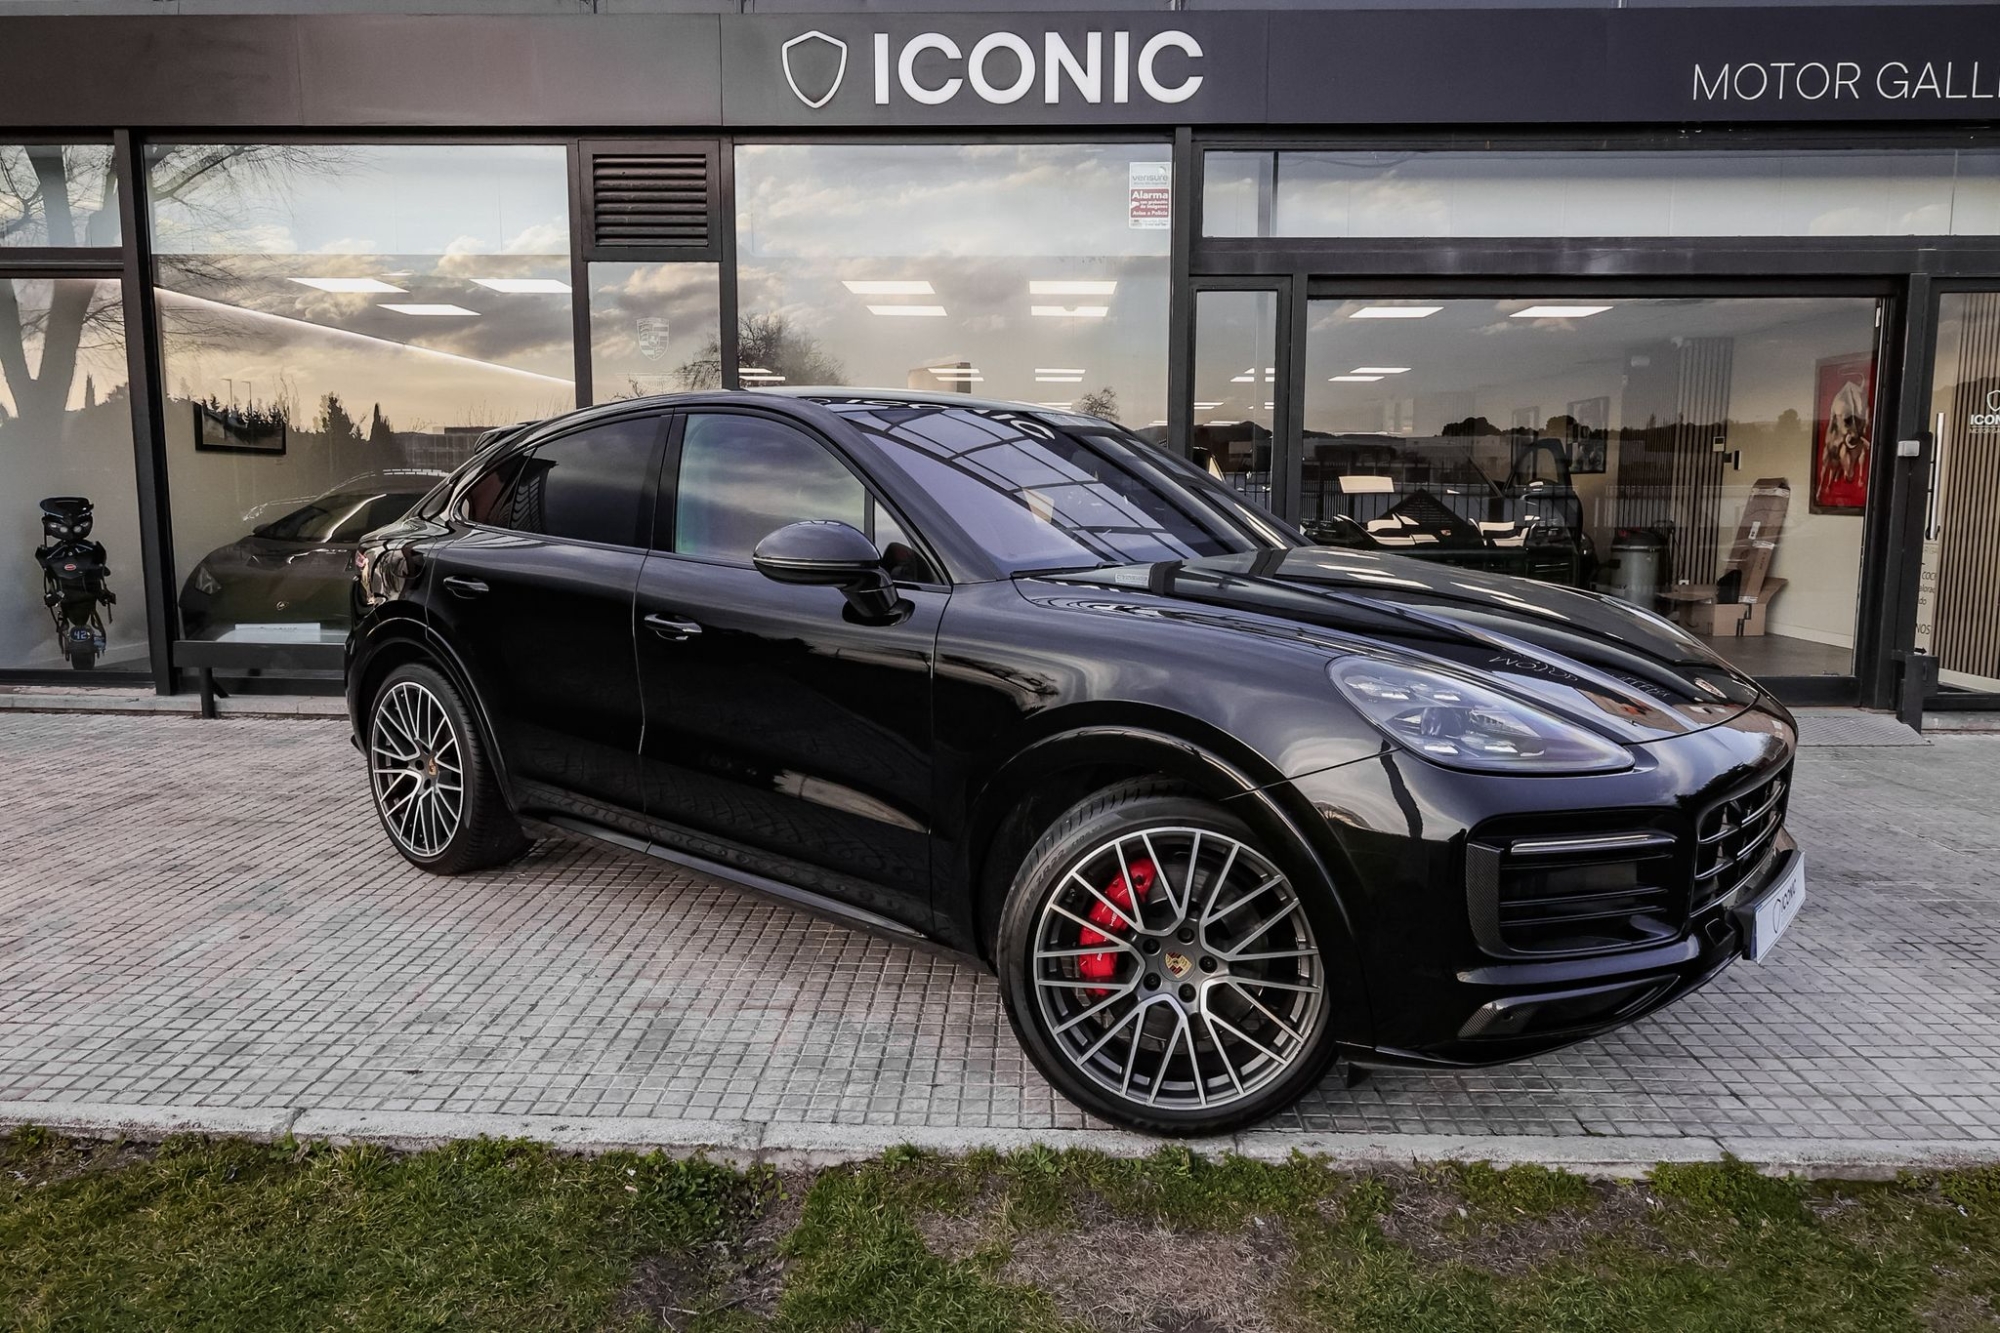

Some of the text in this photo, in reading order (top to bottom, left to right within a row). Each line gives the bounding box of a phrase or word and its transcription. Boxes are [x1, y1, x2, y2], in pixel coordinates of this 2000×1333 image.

[873, 30, 1205, 105] ICONIC
[1692, 61, 2000, 101] MOTOR GALL
[1132, 191, 1168, 199] Alarma
